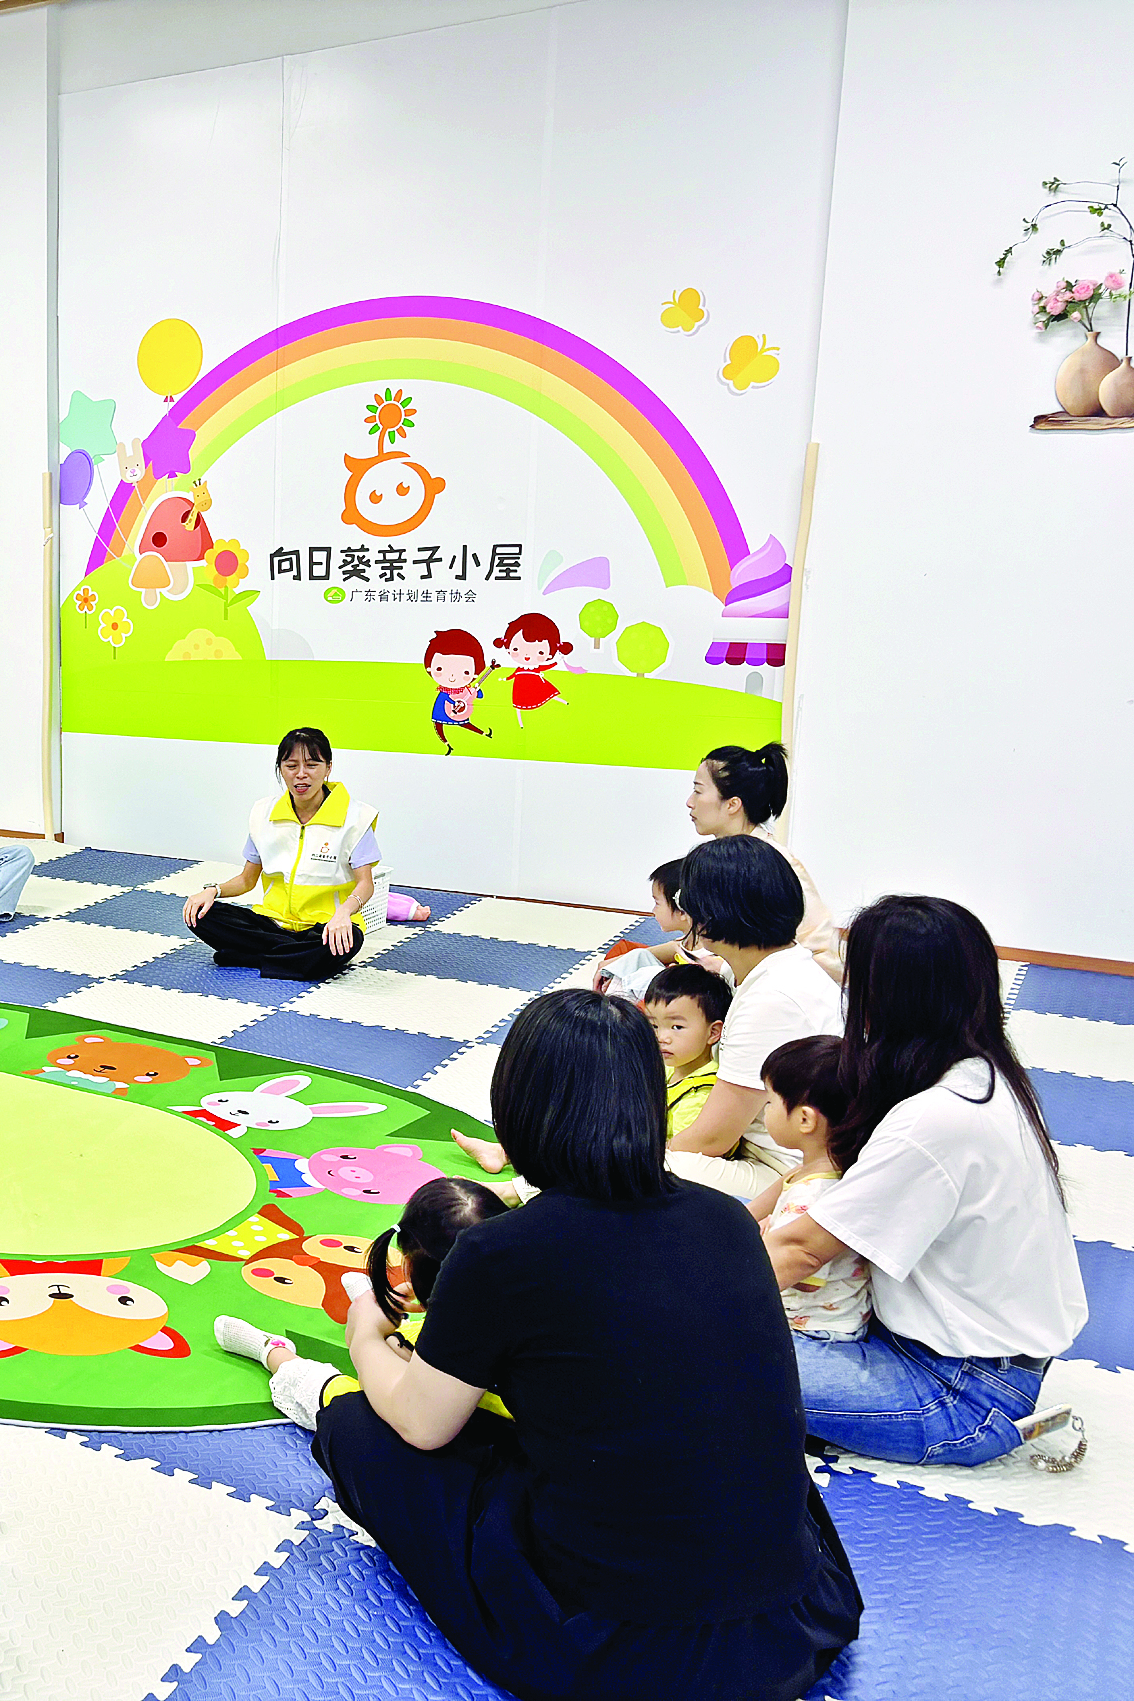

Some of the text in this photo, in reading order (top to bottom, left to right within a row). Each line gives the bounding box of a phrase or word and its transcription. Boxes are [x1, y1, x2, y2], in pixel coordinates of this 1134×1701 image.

[269, 543, 523, 582] 向日葵亲子小屋
[349, 588, 477, 603] 广东省计划生育协会
